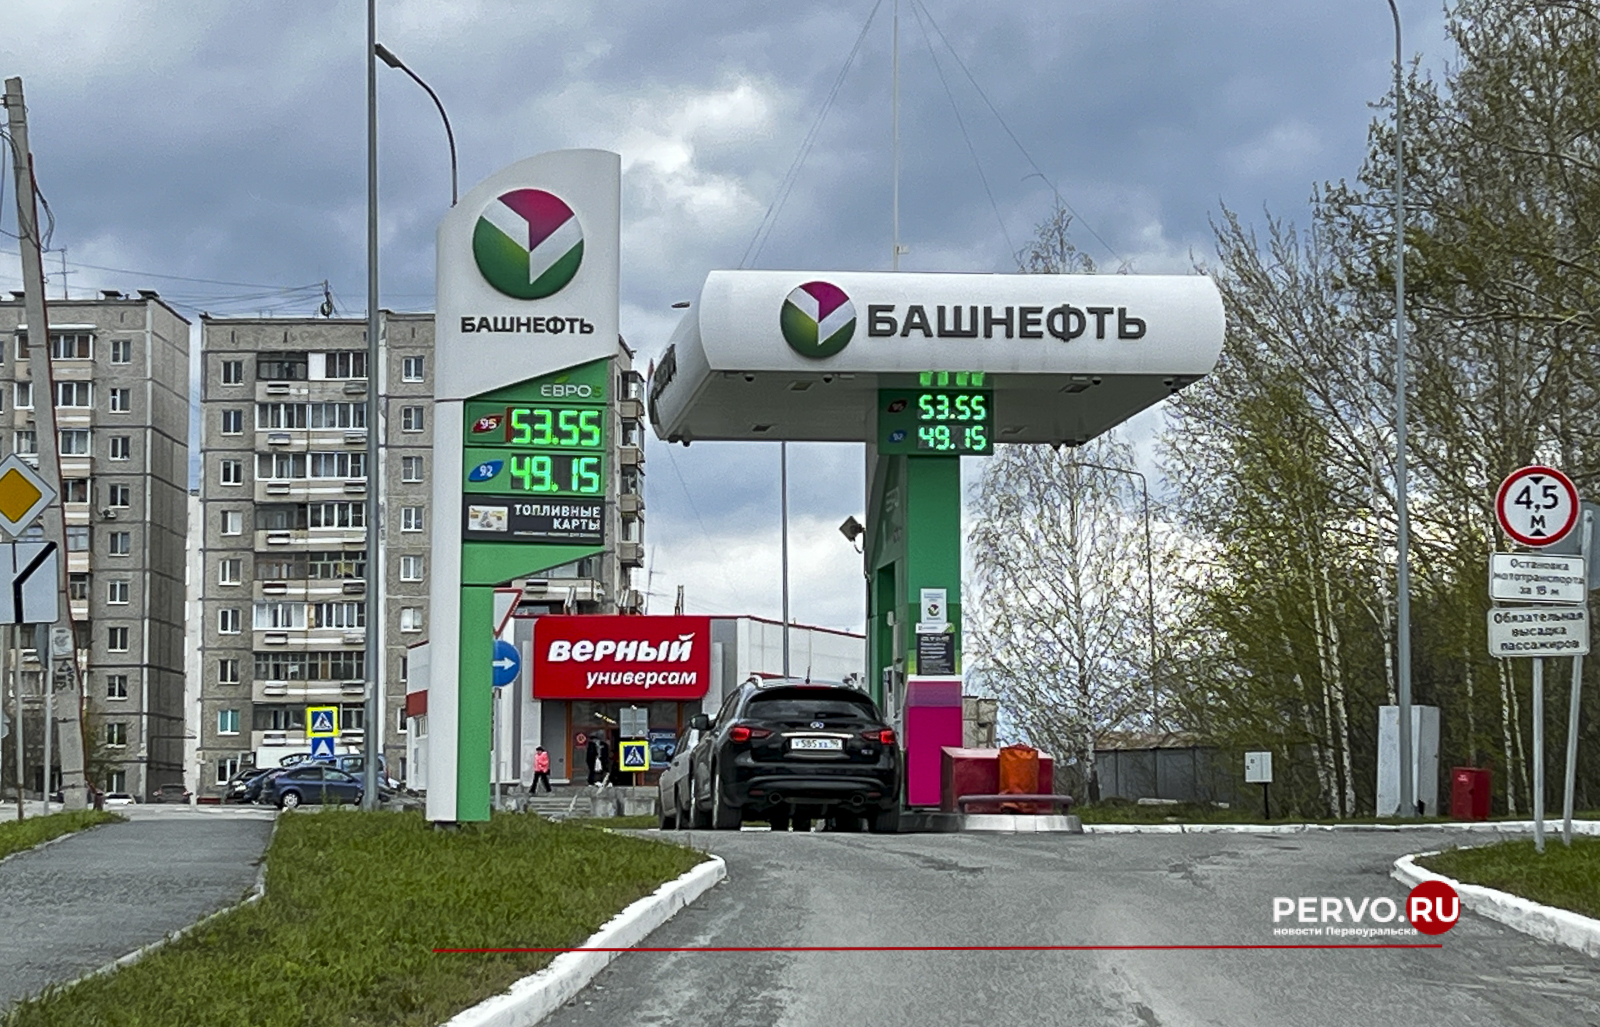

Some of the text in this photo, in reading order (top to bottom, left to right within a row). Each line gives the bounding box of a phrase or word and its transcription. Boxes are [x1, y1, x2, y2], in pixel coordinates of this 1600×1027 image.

[461, 316, 595, 335] БАШНЕФТЬ
[868, 303, 1147, 342] БАШНЕФТЬ
[918, 394, 987, 421] 53.55
[479, 408, 601, 446] 95 53.55
[918, 425, 987, 451] 49.15
[479, 455, 601, 493] 92 49.15
[1514, 485, 1559, 512] 4,5
[514, 504, 601, 518] ТОПЛИВНЫЕ
[553, 519, 601, 531] КАРТЫ
[1510, 558, 1569, 571] Остановка
[1493, 612, 1585, 624] Обязательная
[1511, 627, 1568, 637] высадка
[1500, 640, 1580, 652] пассажиров
[586, 671, 697, 689] универсам
